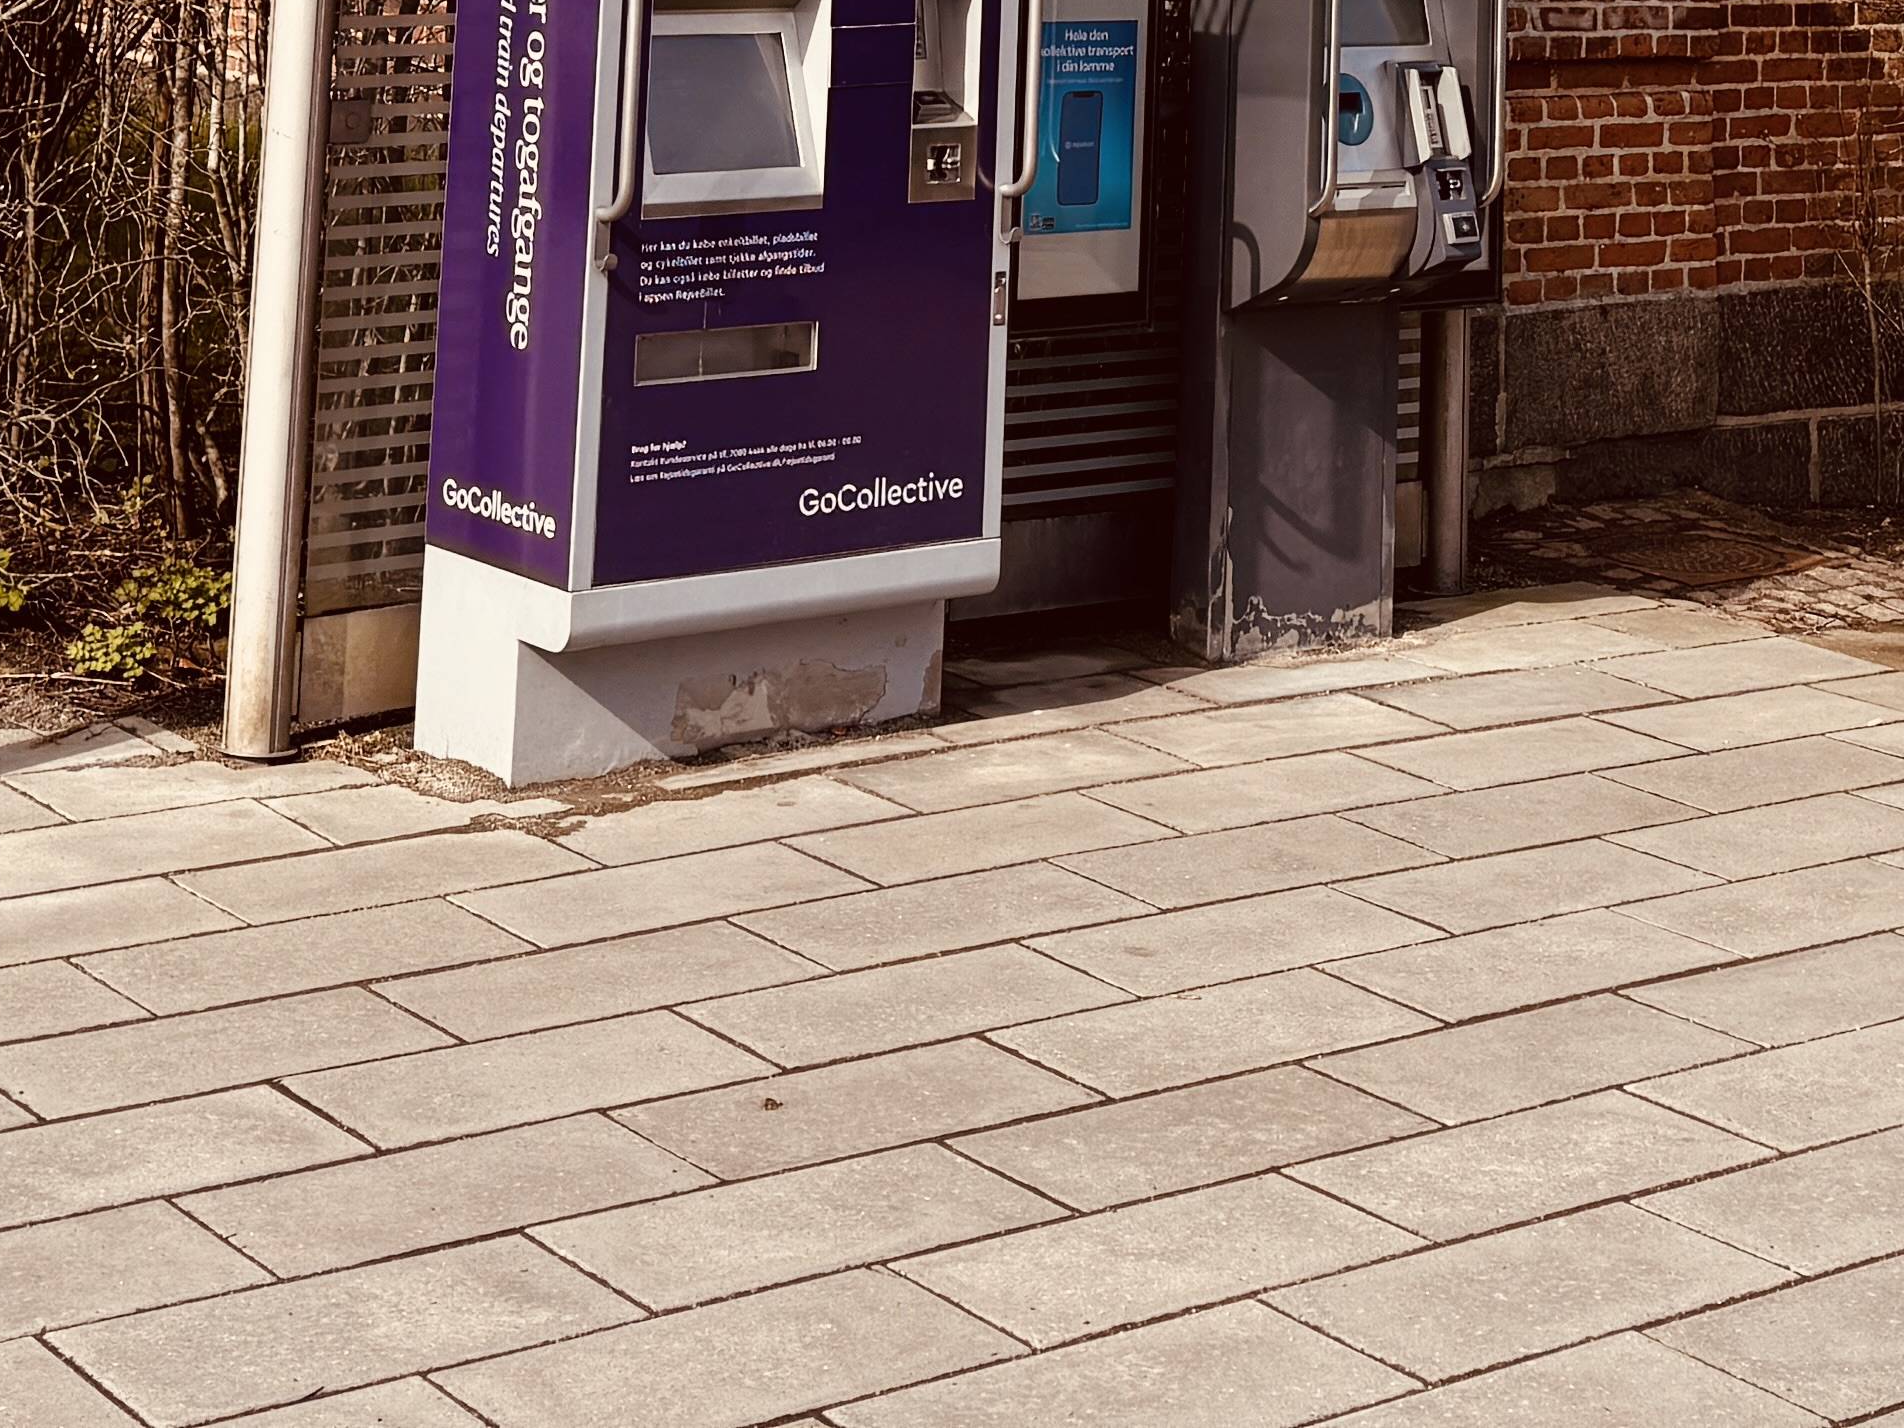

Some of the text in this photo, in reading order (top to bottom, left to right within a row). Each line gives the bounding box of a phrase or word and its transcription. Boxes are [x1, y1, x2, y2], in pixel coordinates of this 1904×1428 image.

[1065, 29, 1109, 41] Hele den
[496, 15, 514, 88] train
[519, 30, 546, 89] og
[1062, 59, 1078, 72] din
[1080, 60, 1115, 72] lomme
[1088, 45, 1134, 58] transport
[486, 92, 512, 257] departures
[505, 96, 545, 350] togafgange
[660, 240, 676, 251] kan
[639, 276, 652, 286] Du
[655, 274, 671, 285] kan
[760, 269, 773, 278] og
[640, 261, 653, 271] og
[443, 478, 556, 539] GoCollective
[798, 472, 964, 516] GoCollective
